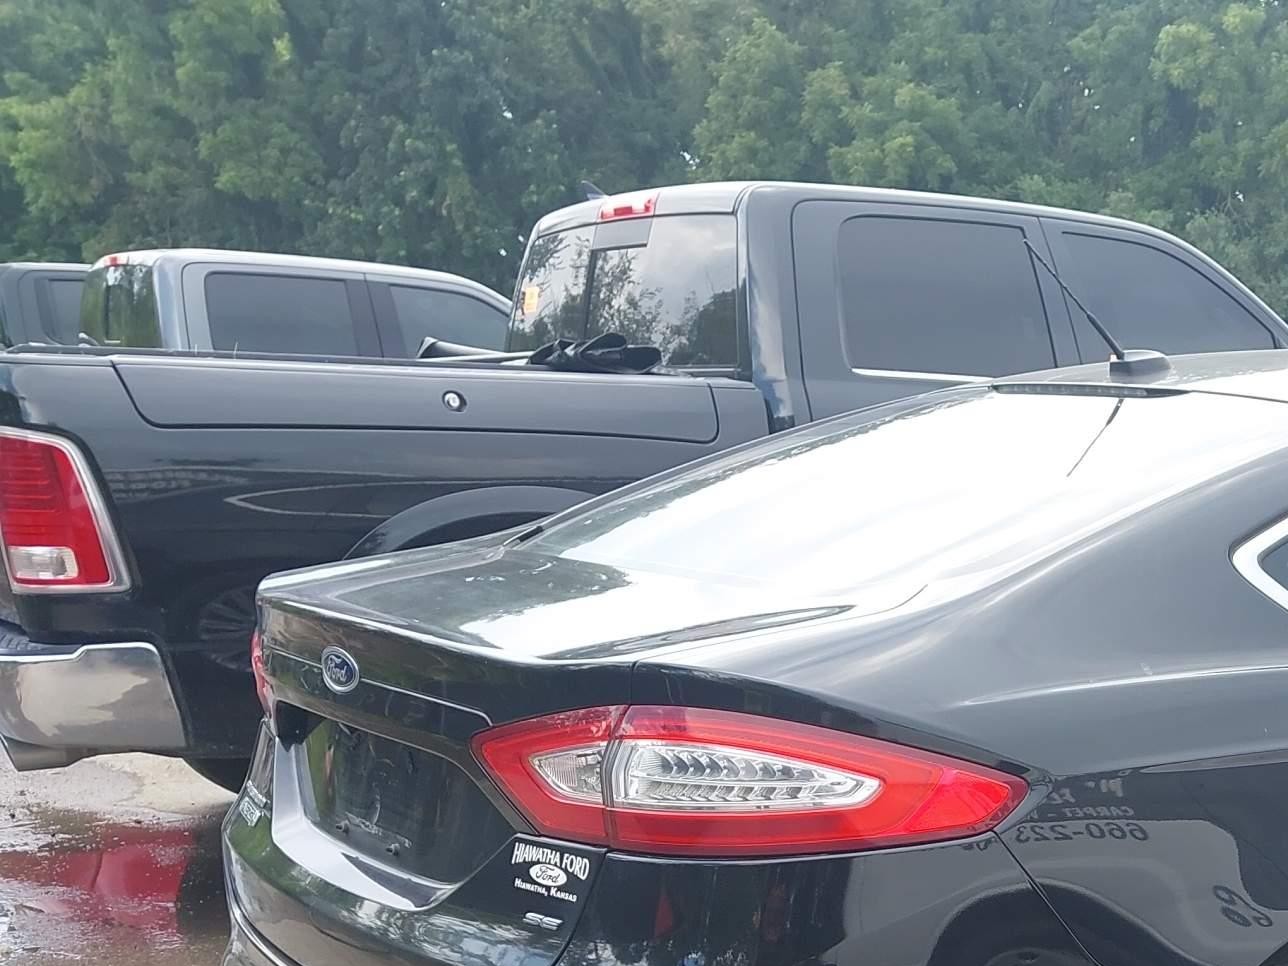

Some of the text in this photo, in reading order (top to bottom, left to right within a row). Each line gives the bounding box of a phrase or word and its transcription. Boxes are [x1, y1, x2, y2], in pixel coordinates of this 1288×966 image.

[511, 842, 590, 881] HIAWATHA FORD
[535, 865, 561, 883] Ford
[522, 912, 563, 931] SE
